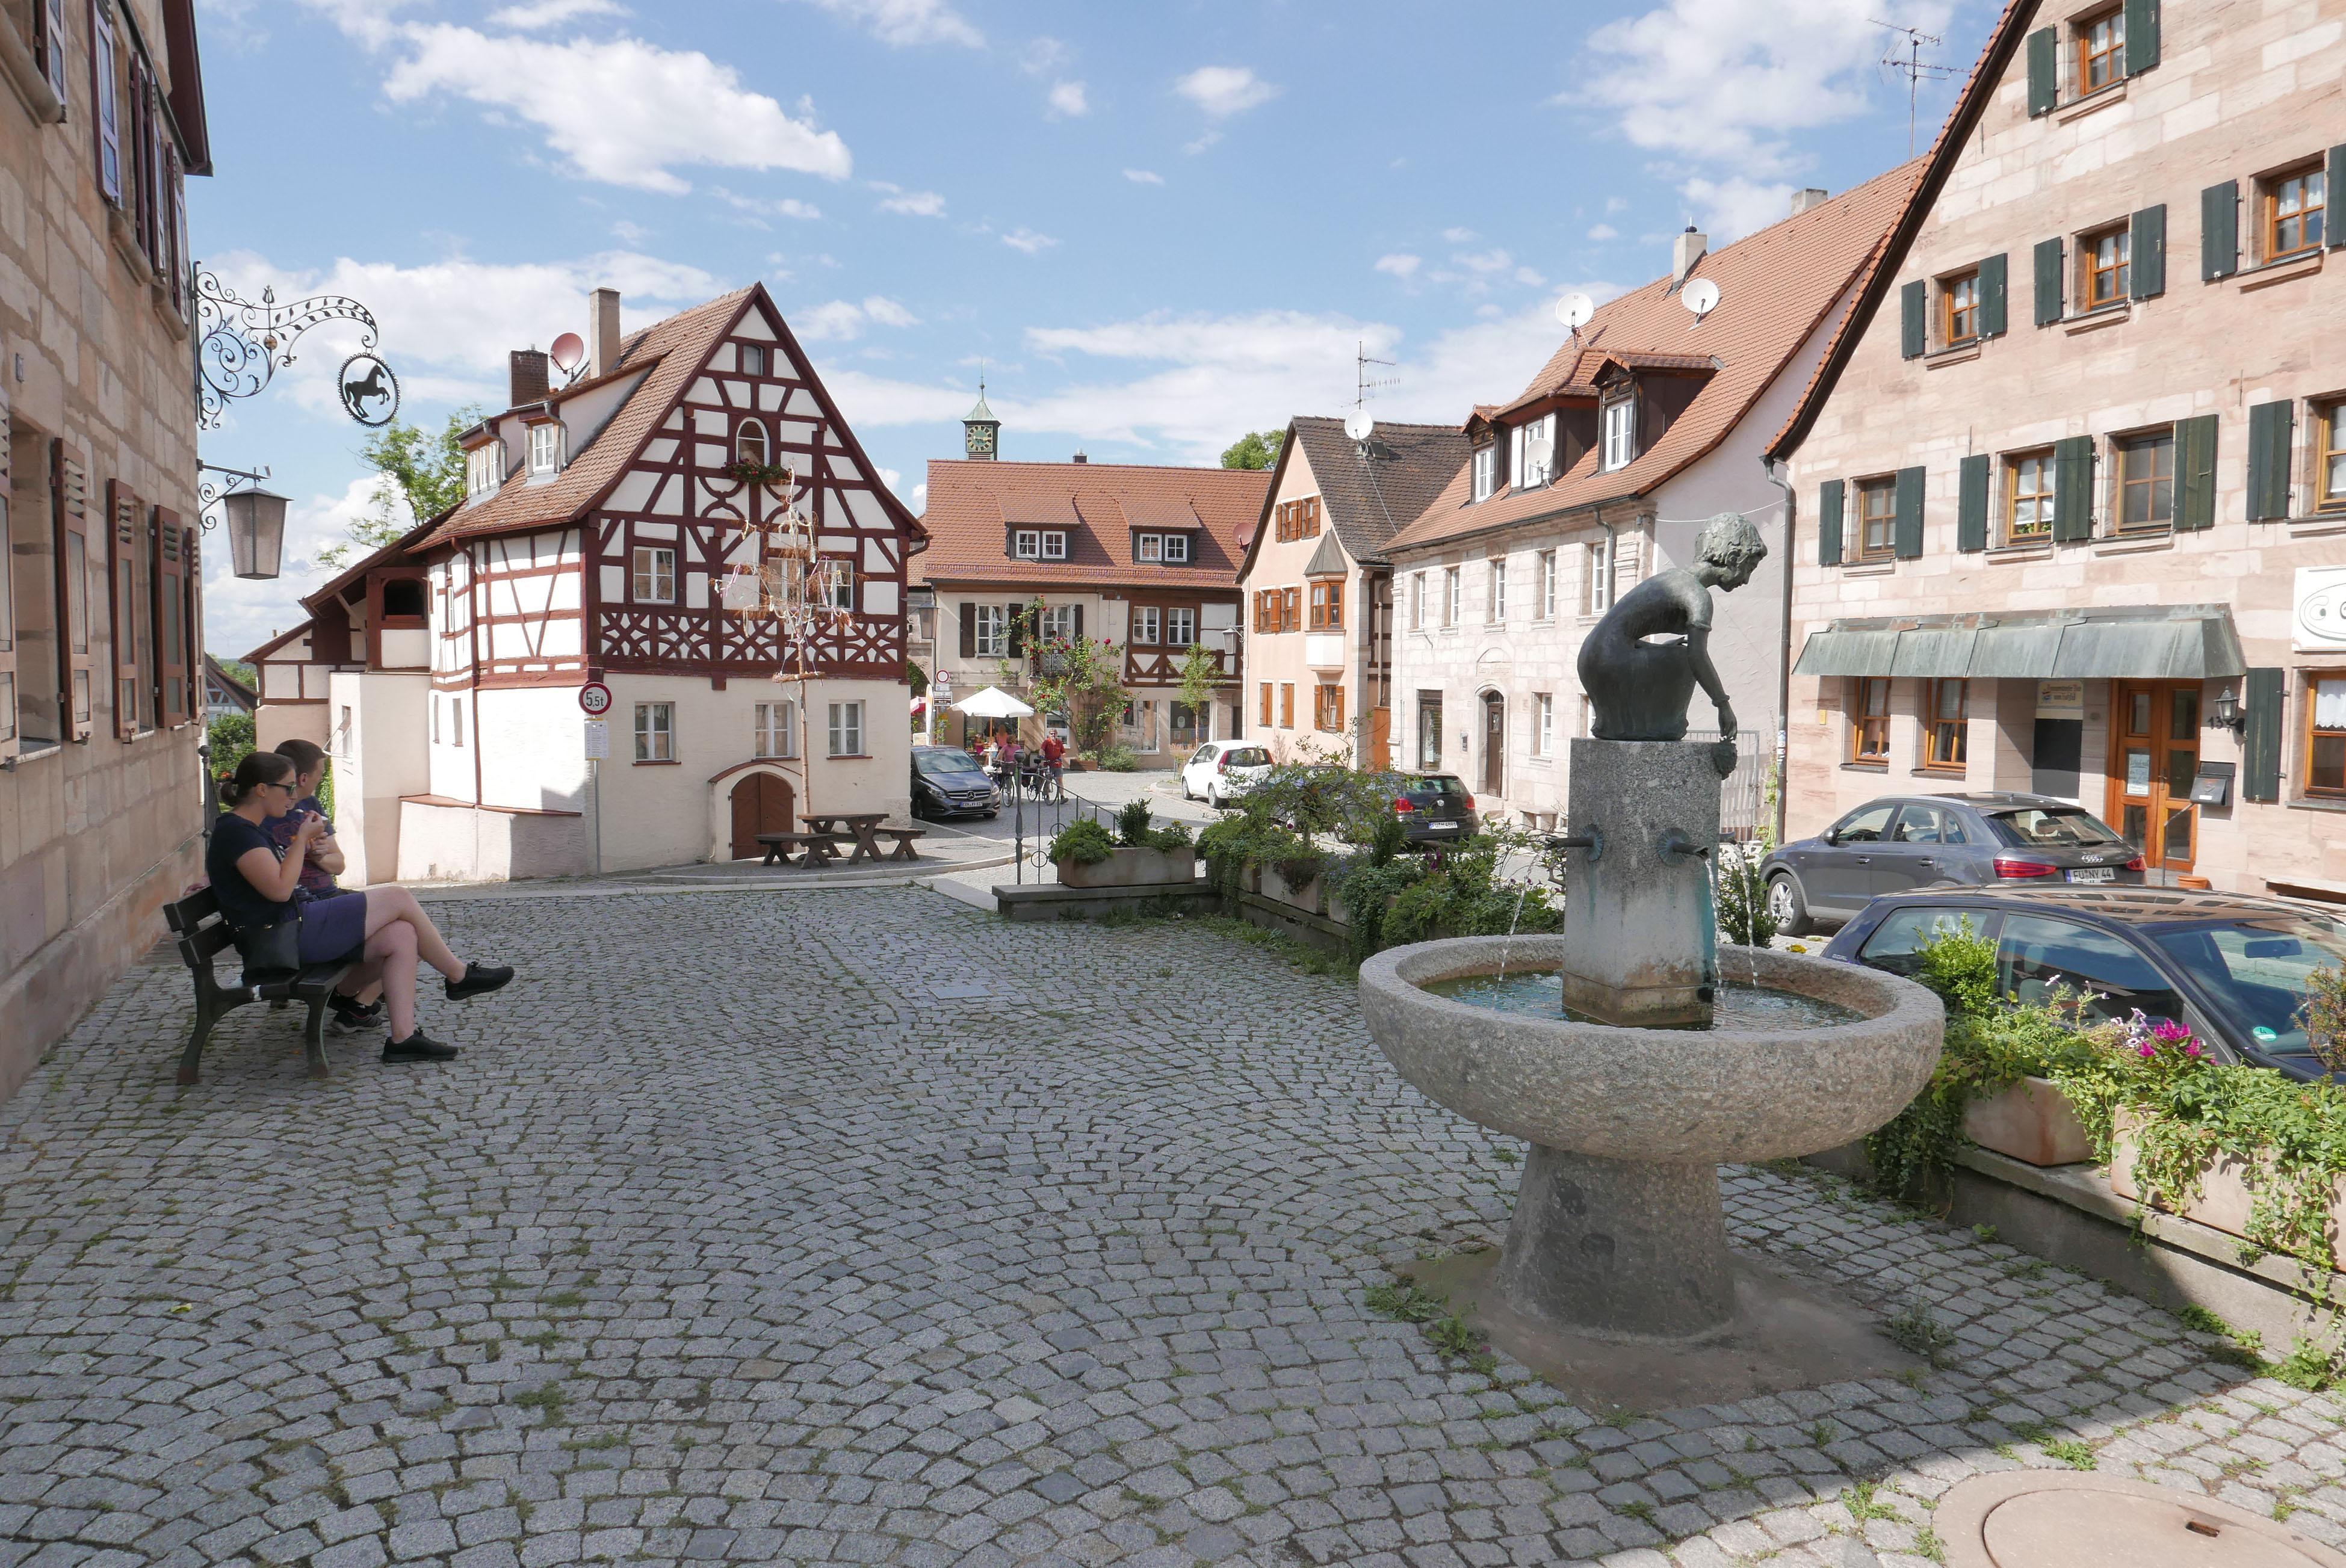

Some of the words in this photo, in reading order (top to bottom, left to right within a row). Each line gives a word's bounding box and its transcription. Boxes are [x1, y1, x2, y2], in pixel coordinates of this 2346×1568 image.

[2208, 717, 2223, 729] 13
[2088, 869, 2099, 879] NY
[2101, 869, 2111, 878] 44
